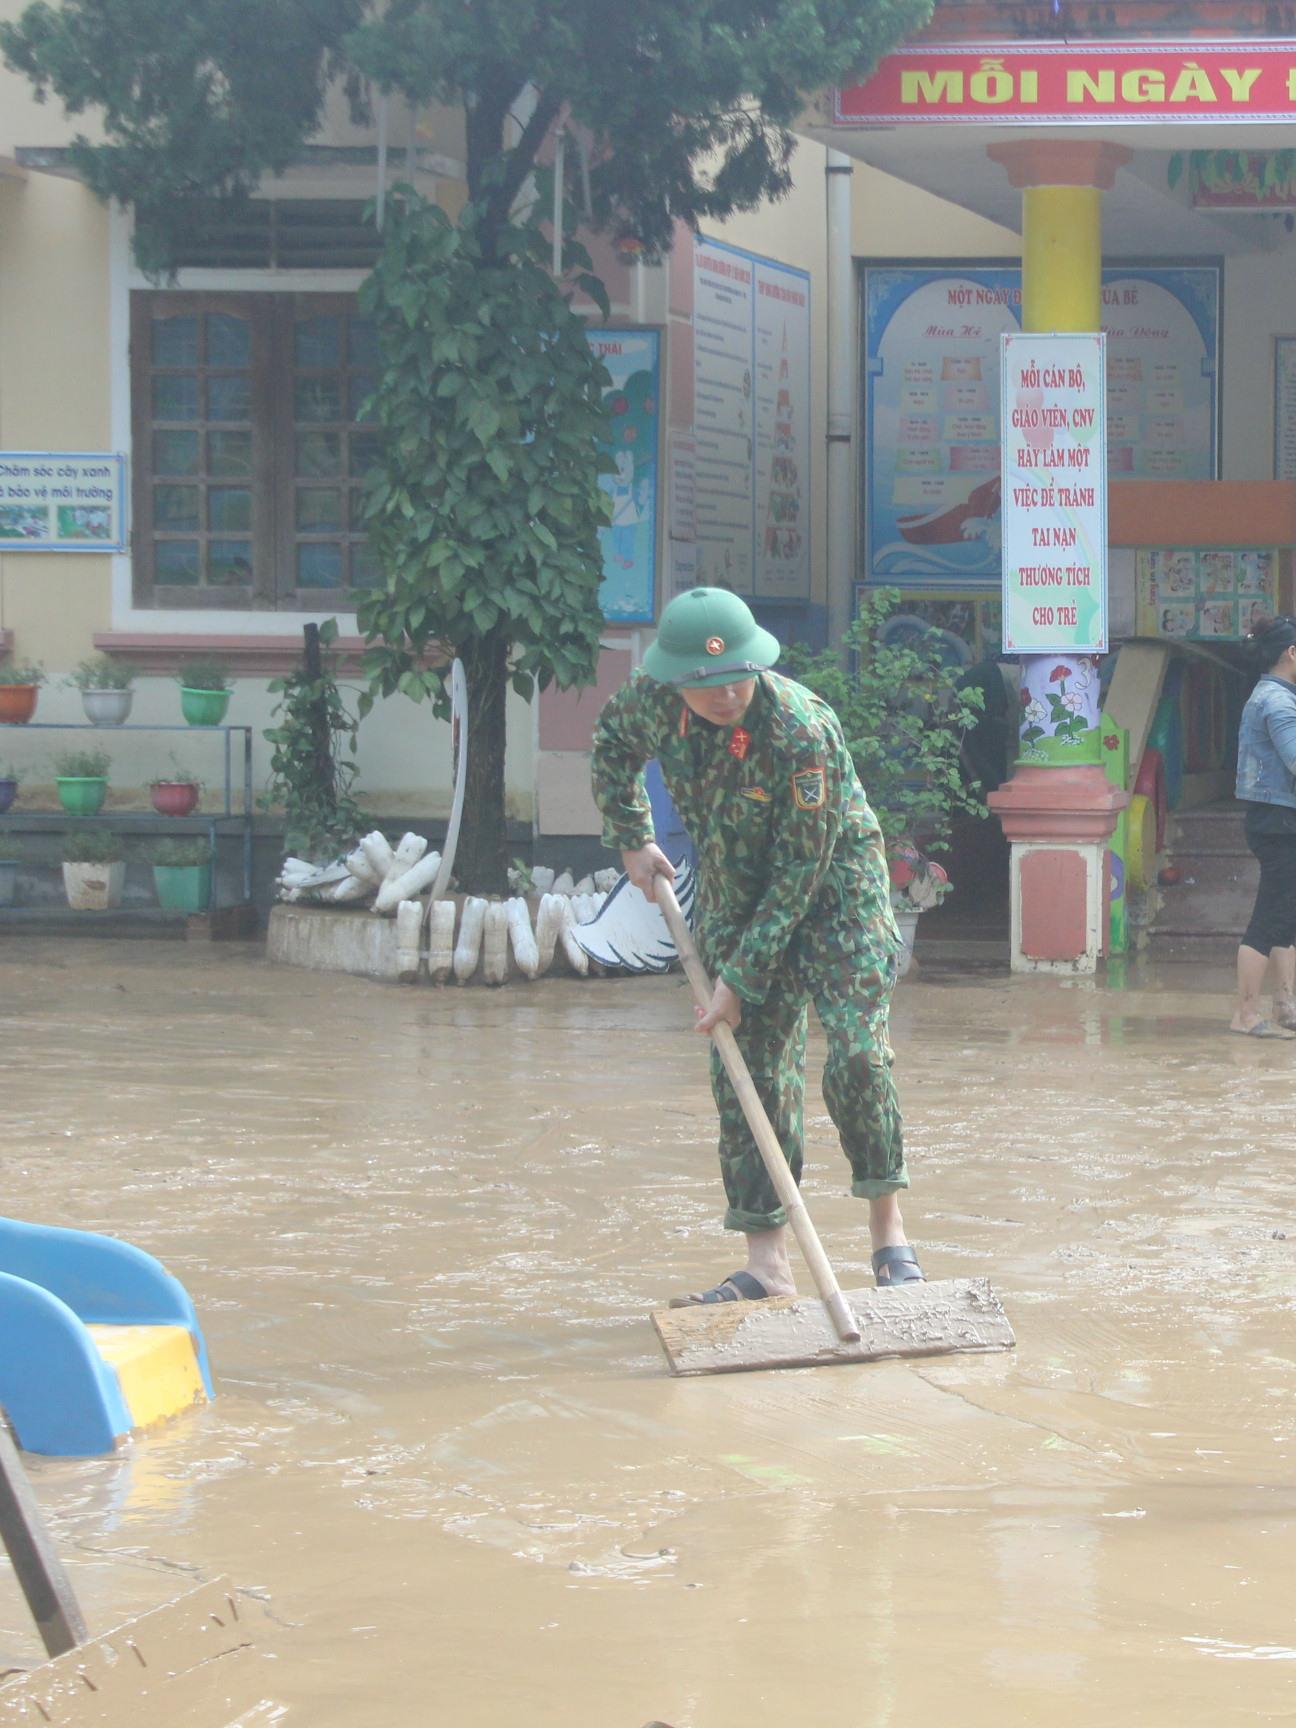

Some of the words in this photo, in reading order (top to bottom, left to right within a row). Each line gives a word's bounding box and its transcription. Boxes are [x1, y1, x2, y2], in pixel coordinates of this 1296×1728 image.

[901, 59, 1038, 104] MỖI
[1066, 62, 1261, 104] NGÀY
[947, 284, 974, 309] MỘT
[1100, 284, 1121, 305] ỦA
[1123, 284, 1139, 305] BÉ
[1020, 359, 1040, 388] MỖI
[1043, 364, 1066, 388] CÁN
[1068, 363, 1086, 394] BỘ,
[1011, 404, 1039, 428] GIÁO
[1041, 403, 1070, 433] VIÊN,
[1072, 408, 1095, 428] CNV
[1017, 443, 1043, 468] HÃY
[1043, 444, 1065, 468] LÀM
[1067, 443, 1090, 473] MỘT
[33, 464, 54, 477] sóc
[57, 464, 79, 480] cây
[82, 466, 111, 477] xanh
[8, 484, 31, 498] bảo
[34, 486, 49, 501] vệ
[51, 486, 73, 498] môi
[75, 485, 113, 502] trường
[1013, 483, 1038, 513] VIỆC
[1041, 476, 1055, 508] ĐỂ
[1057, 483, 1095, 508] TRÁNH
[1031, 527, 1050, 547] TAI
[1053, 527, 1077, 552] NẠN
[1018, 564, 1063, 587] THƯƠNG
[1065, 562, 1091, 587] TÍCH
[1032, 606, 1054, 626] CHO
[1056, 599, 1077, 626] TRẺ
